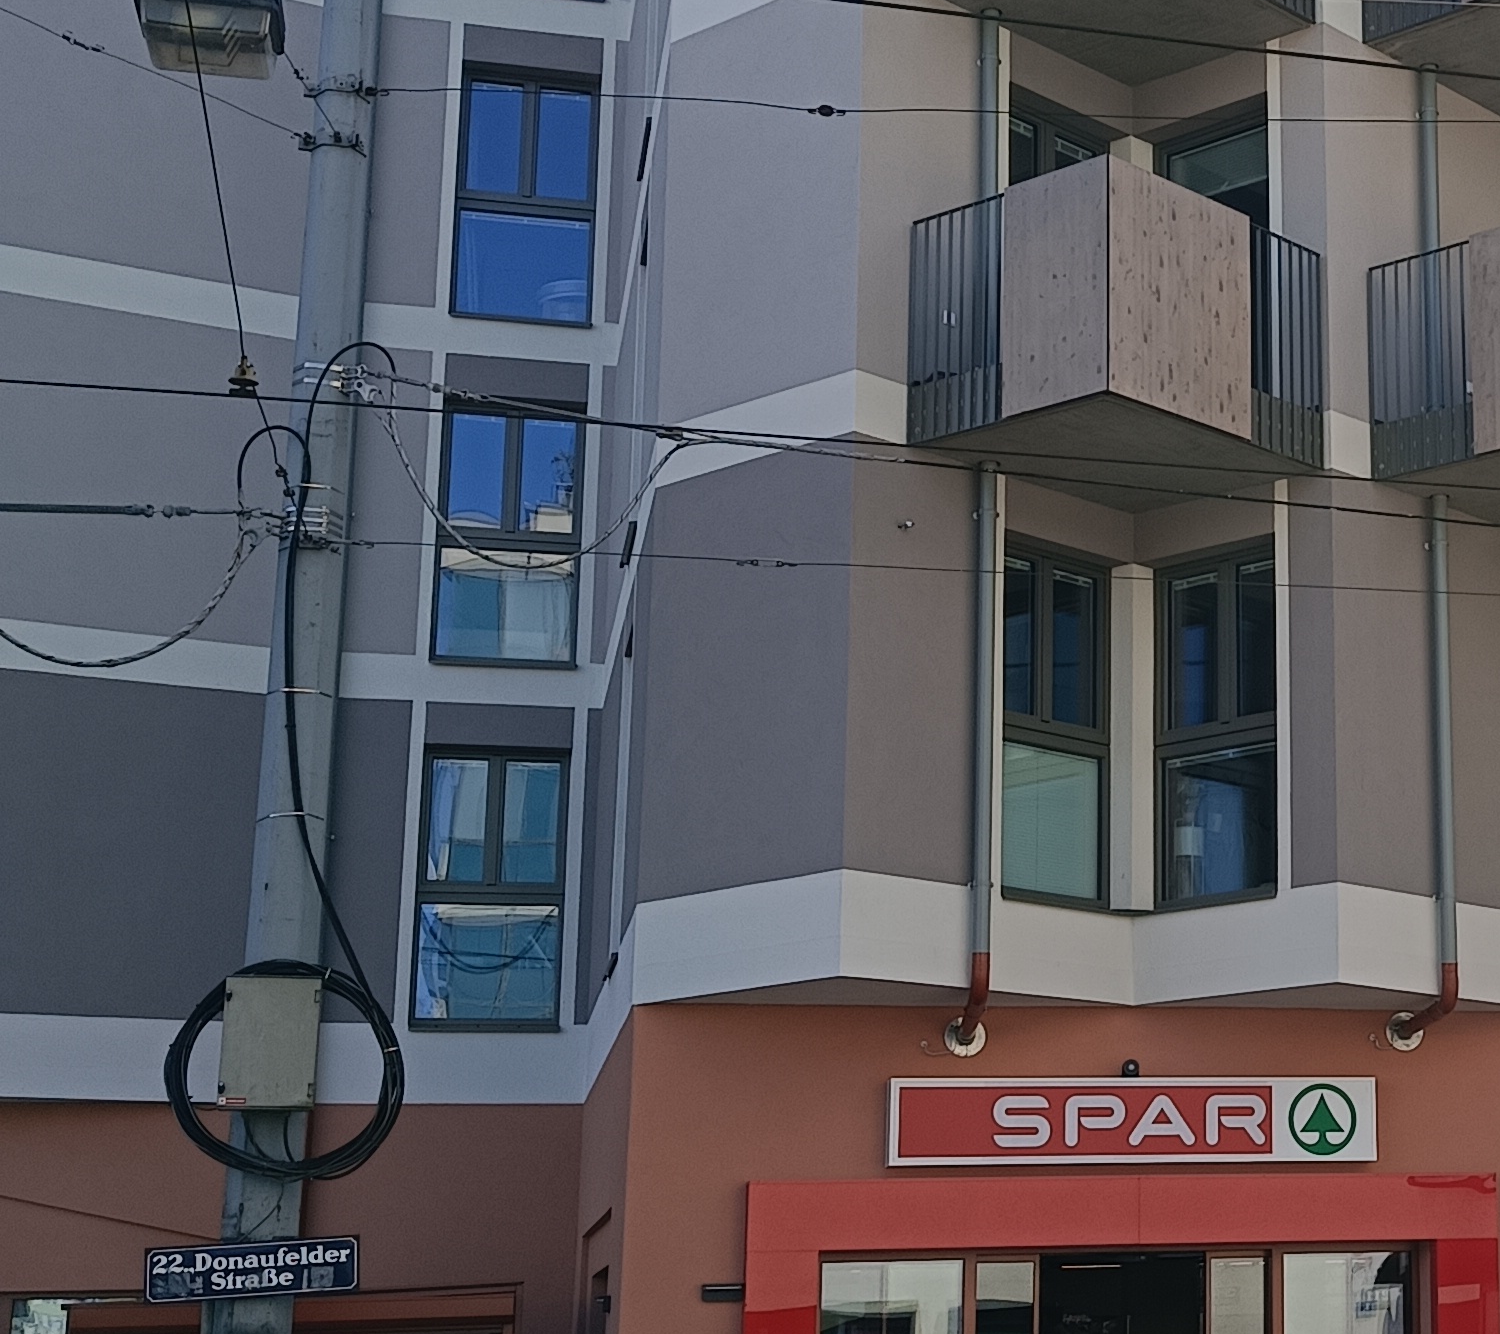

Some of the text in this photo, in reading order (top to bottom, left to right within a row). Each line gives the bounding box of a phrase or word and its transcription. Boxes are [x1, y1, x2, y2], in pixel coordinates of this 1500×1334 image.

[993, 1094, 1267, 1147] SPAR
[194, 1245, 350, 1272] Donaufelder
[211, 1268, 295, 1290] Straße
